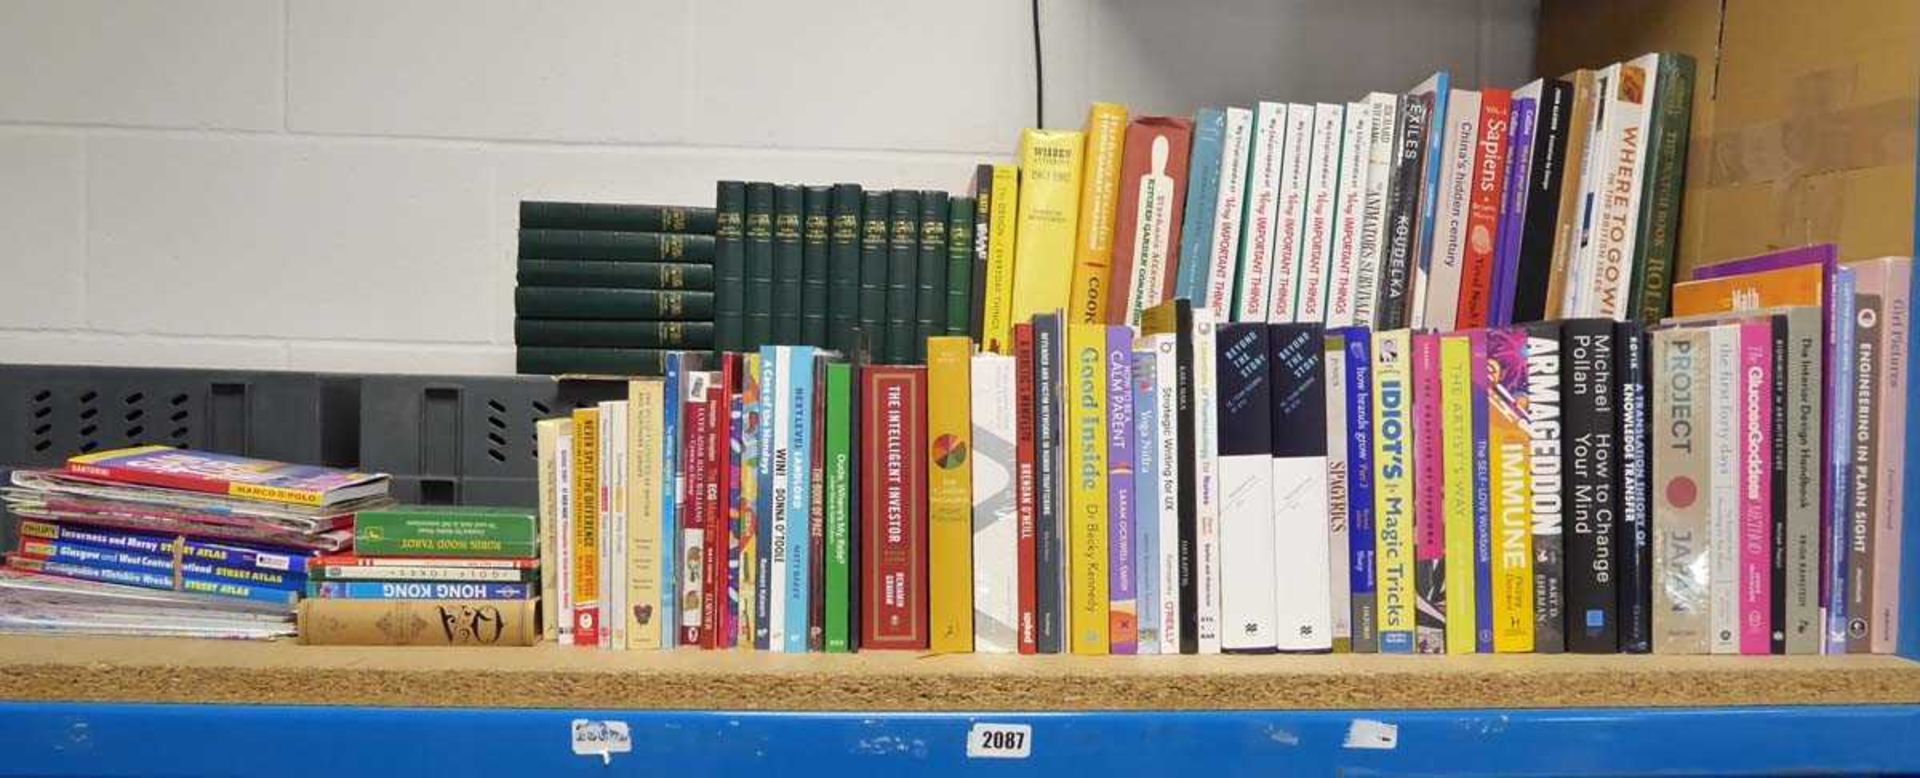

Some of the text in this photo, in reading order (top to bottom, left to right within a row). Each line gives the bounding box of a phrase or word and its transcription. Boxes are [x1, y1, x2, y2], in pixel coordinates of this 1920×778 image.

[1404, 103, 1423, 160] EXILES
[1524, 109, 1533, 135] Collins
[1479, 119, 1506, 192] Sapiens
[1614, 127, 1638, 208] WHERE
[1444, 122, 1473, 267] China's hidden century
[1604, 187, 1615, 210] THE
[1216, 222, 1235, 278] IMPORTANT
[1251, 217, 1269, 274] IMPORTANT
[1280, 218, 1296, 275] IMPORTANT
[1308, 217, 1325, 274] IMPORTANT
[1339, 218, 1355, 274] IMPORTANT
[1598, 213, 1611, 259] BRITISH
[1610, 215, 1627, 242] TO
[1388, 216, 1408, 299] KOUDELKA
[1604, 249, 1622, 281] GO
[1356, 261, 1372, 315] SURVIVAL
[1573, 334, 1590, 395] Pollan
[1889, 299, 1903, 389] Girl Pictures
[762, 369, 772, 393] Case
[762, 395, 772, 407] of
[1111, 350, 1125, 448] CALM PARENT
[1124, 366, 1132, 387] HOW
[1124, 388, 1132, 401] TO
[1356, 367, 1367, 390] how
[1594, 334, 1610, 413] Michael
[1857, 343, 1872, 442] ENGINEERING
[762, 409, 771, 426] the
[1080, 347, 1102, 489] Good Inside
[1138, 410, 1151, 437] Yoga
[1357, 393, 1368, 430] brands
[1382, 380, 1402, 480] IDIOT'S
[1527, 338, 1562, 535] ARMAGEDDON
[1717, 344, 1732, 475] the first forty days
[1797, 338, 1813, 508] The Interior Design Handbook
[761, 429, 771, 475] Mondays
[887, 386, 901, 543] THE INTELLIGENT INVESTOR
[1162, 387, 1174, 512] Strategic Writing for UX
[1355, 432, 1367, 459] grow
[1451, 365, 1466, 518] THE ARTIST'S WAY
[1624, 384, 1634, 522] KNOWLEDGE TRANSFER
[1635, 384, 1646, 546] A TRANSLATION THEORY OF
[1858, 446, 1869, 461] IN
[584, 420, 594, 547] NEVER SPLIT THE DIFFERENCE
[774, 488, 784, 521] DONNA
[792, 452, 802, 510] LANDLORD
[1021, 463, 1032, 539] BRENDAN O'NEILL
[1118, 489, 1128, 517] SARAH
[1202, 476, 1210, 504] Nurses
[1329, 461, 1346, 533] SPAGYRICS
[1477, 440, 1488, 562] The SELF-LOVE Workbook
[1574, 433, 1592, 535] Your Mind
[1671, 340, 1692, 612] PROJECT JAPAN
[1855, 465, 1867, 507] PLAIN
[1500, 443, 1526, 569] IMMUNE
[1593, 434, 1612, 583] How to Change
[1854, 511, 1866, 553] SIGHT
[60, 546, 100, 560] Glasgow
[216, 567, 250, 579] STREET
[252, 574, 282, 583] ATLAS
[61, 529, 107, 543] Inverness
[109, 537, 125, 545] and
[196, 549, 227, 560] ATLAS
[774, 524, 784, 563] O'TOOLE
[1085, 504, 1099, 612] Dr Becky Kennedy
[1382, 498, 1403, 626] Magic Tricks
[185, 581, 249, 596] STREET ATLAS
[383, 583, 486, 598] HONG KONG
[1536, 574, 1547, 622] EHRMAN
[1548, 578, 1557, 602] BART
[1165, 601, 1174, 644] O'REILLY
[982, 731, 1025, 749] 2087
